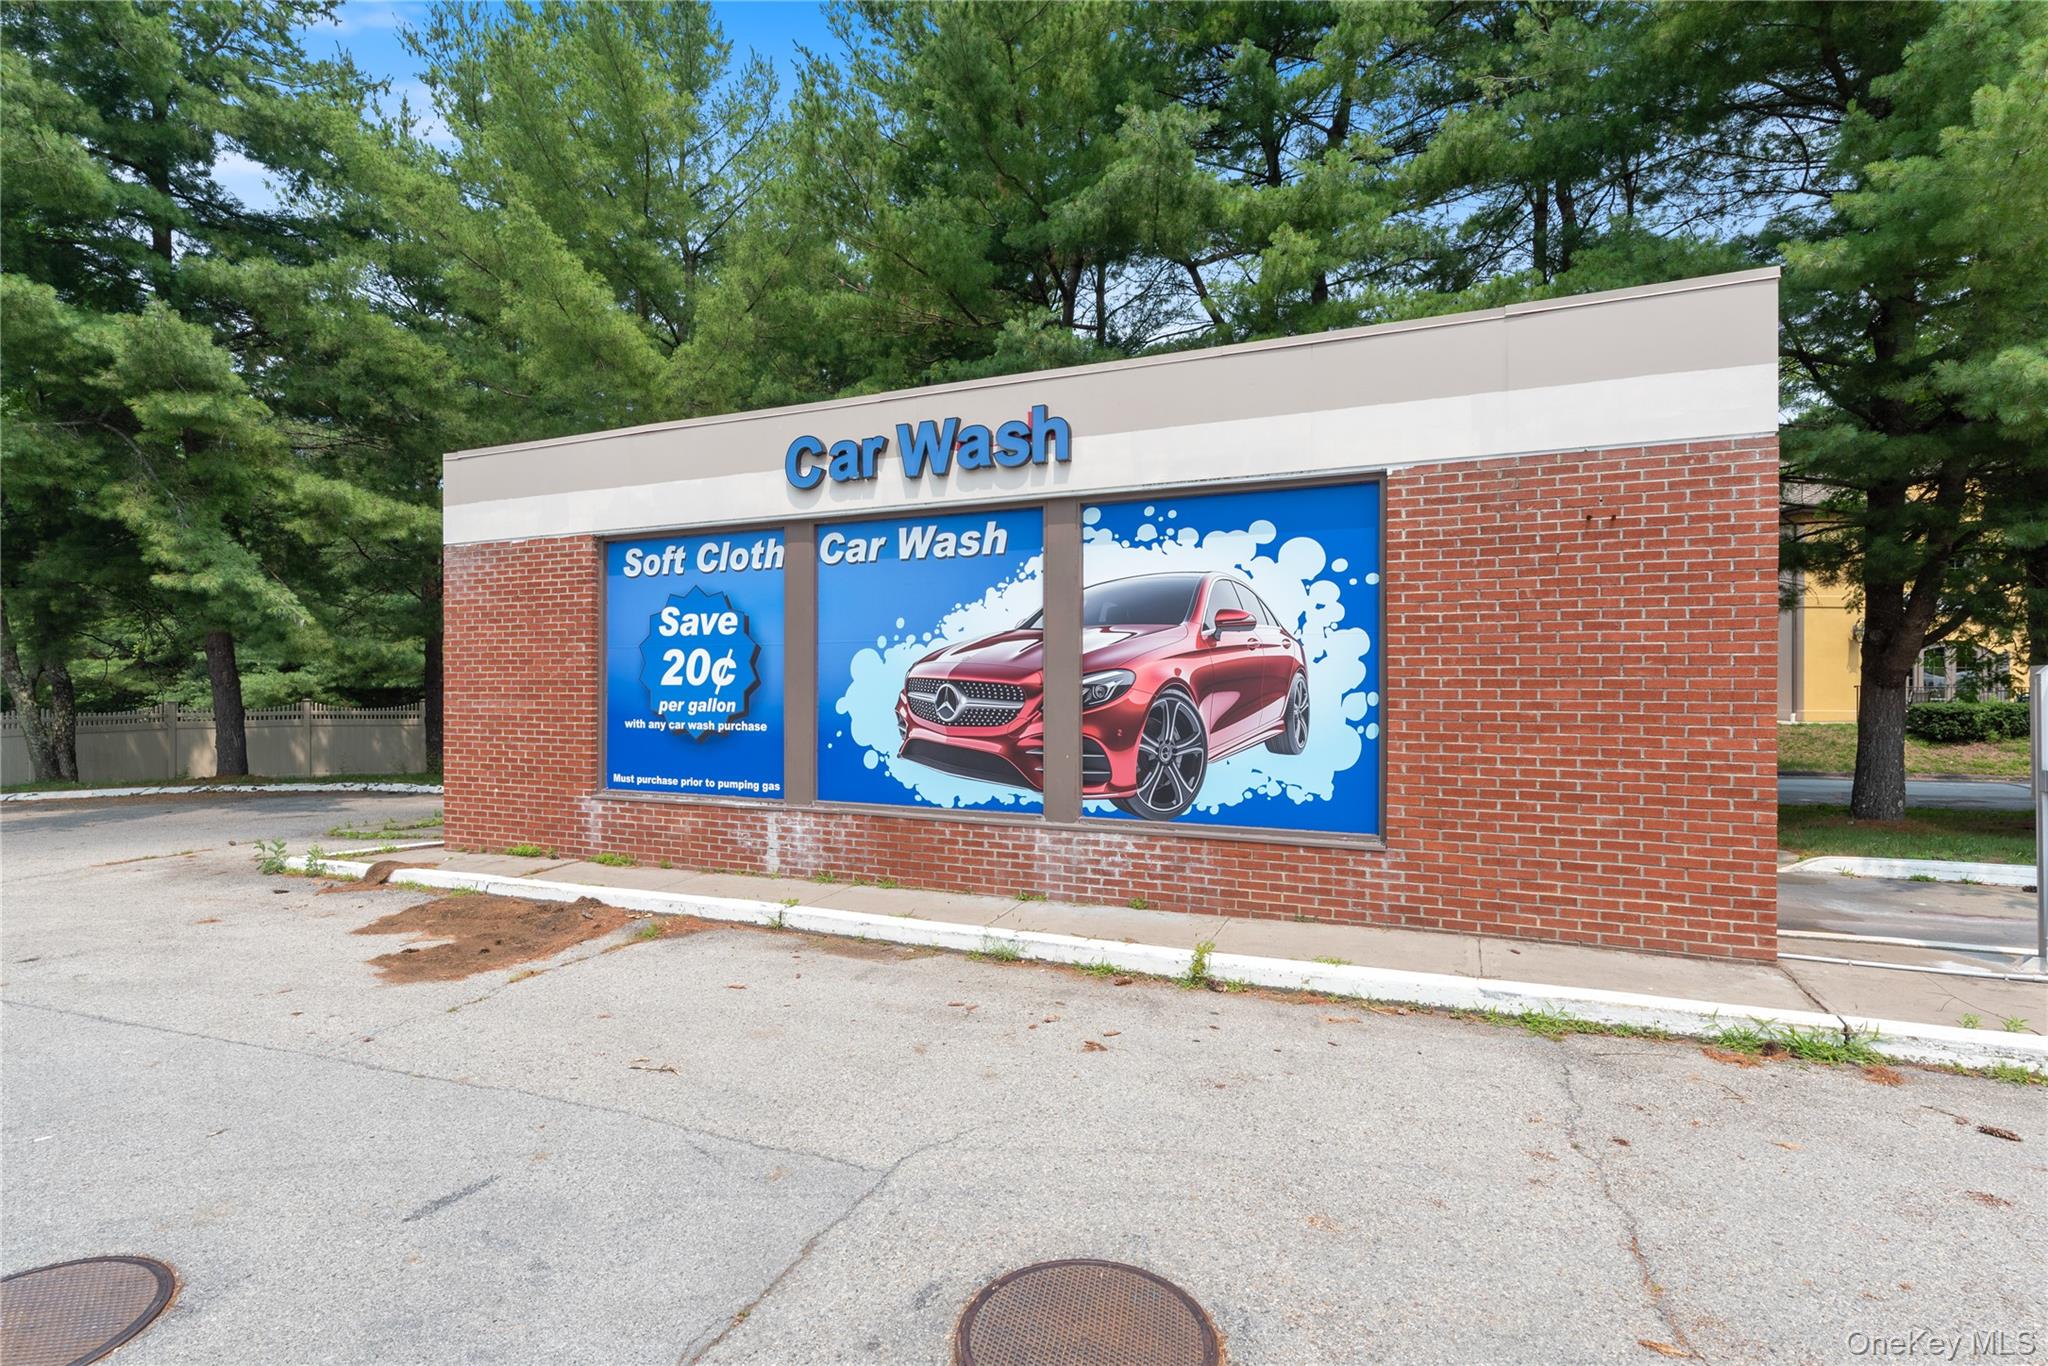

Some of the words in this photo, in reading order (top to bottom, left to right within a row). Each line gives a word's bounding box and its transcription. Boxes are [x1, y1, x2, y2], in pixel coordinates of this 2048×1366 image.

[784, 434, 889, 490] Car
[896, 404, 1072, 479] Wash
[623, 545, 687, 578] Soft
[696, 538, 785, 573] Cloth
[819, 532, 887, 565] Car
[898, 520, 1008, 561] Wash
[658, 606, 738, 637] Save
[660, 648, 737, 695] 20¢
[658, 700, 684, 715] per
[688, 698, 736, 715] gallon
[624, 719, 646, 729] with
[648, 721, 666, 732] any
[668, 721, 685, 730] car
[687, 720, 715, 731] wash
[718, 721, 768, 733] purchase
[613, 773, 634, 784] Must
[636, 774, 678, 786] purchase
[680, 777, 703, 789] prior
[704, 778, 715, 788] to
[717, 780, 760, 792] pumping
[762, 782, 781, 793] gas
